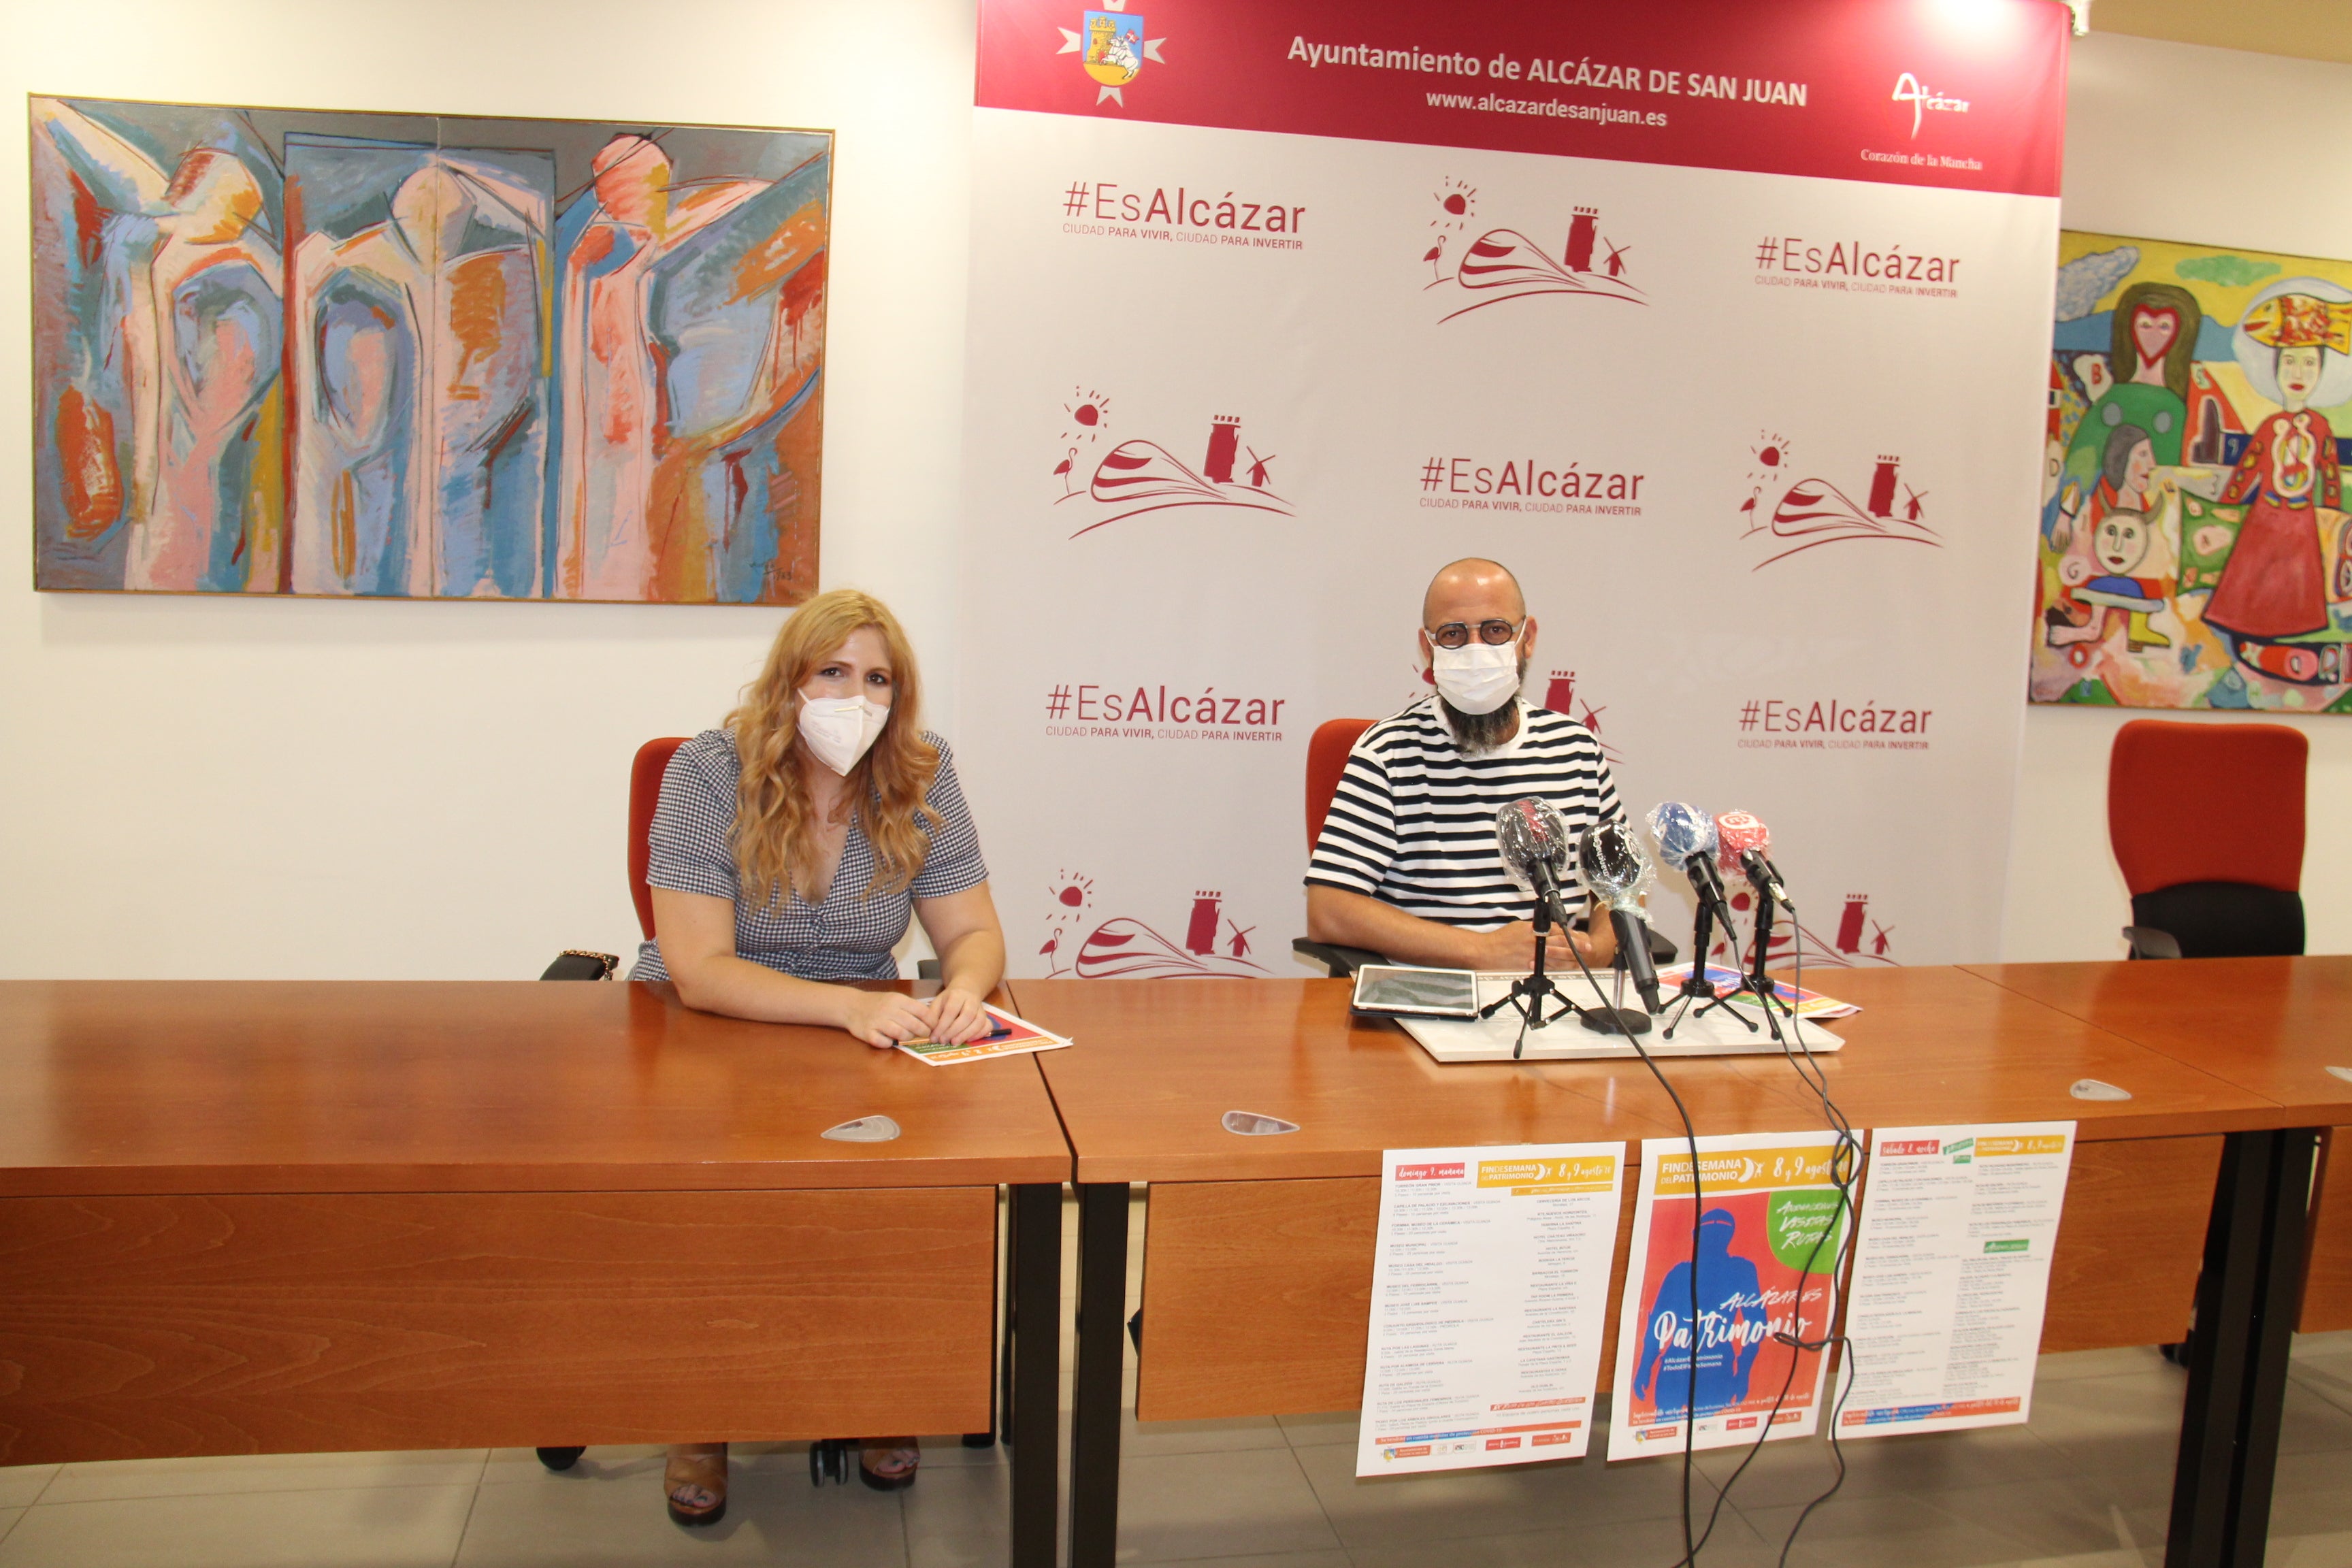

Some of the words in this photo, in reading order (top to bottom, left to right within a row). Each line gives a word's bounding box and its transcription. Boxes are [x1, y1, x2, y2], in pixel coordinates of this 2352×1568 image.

[1287, 36, 1481, 76] Ayuntamiento
[1488, 53, 1521, 80] de
[1527, 56, 1641, 91] ALCÁZAR
[1649, 69, 1680, 95] DE
[1687, 73, 1737, 100] SAN
[1742, 78, 1808, 107] JUAN
[1426, 92, 1667, 127] www.alcazardesanjuan.es
[1860, 148, 1908, 165] Corazón
[1910, 152, 1925, 165] de
[1927, 154, 1938, 167] la
[1940, 155, 1983, 170] Mancha
[1062, 181, 1305, 233] #EsAlcázar
[1062, 223, 1105, 235] CIUDAD
[1108, 226, 1137, 239] PARA
[1141, 229, 1173, 242] VIVIR,
[1176, 231, 1218, 245] CIUDAD
[1220, 235, 1250, 247] PARA
[1252, 238, 1303, 250] INVERTIR
[1756, 236, 1959, 283] #EsAlcázar
[1754, 275, 1792, 287] CIUDAD
[1793, 278, 1818, 289] PARA
[1821, 280, 1849, 292] VIVIR,
[1851, 282, 1886, 293] CIUDAD
[1889, 284, 1912, 295] PARA
[1915, 287, 1957, 298] INVERTIR
[1420, 457, 1644, 500] #EsAlcázar
[1420, 497, 1458, 509] CIUDAD
[1462, 500, 1489, 510] PARA
[1492, 501, 1522, 513] VIVIR,
[1524, 502, 1563, 514] CIUDAD
[1566, 504, 1592, 514] PARA
[1595, 505, 1642, 517] INVERTIR
[1045, 684, 1285, 725] #EsAlcázar
[1739, 700, 1932, 734] #EsAlcázar
[1045, 725, 1087, 737] CIUDAD
[1090, 727, 1120, 738] PARA
[1122, 728, 1154, 740] VIVIR,
[1157, 728, 1198, 740] CIUDAD
[1201, 730, 1230, 740] PARA
[1232, 731, 1282, 742] INVERTIR
[1737, 739, 1771, 749] CIUDAD
[1774, 739, 1797, 749] PARA
[1799, 740, 1825, 750] VIVIR,
[1827, 740, 1861, 749] CIUDAD
[1863, 740, 1885, 749] PARA
[1888, 740, 1929, 750] INVERTIR
[1399, 1166, 1427, 1179] domingo
[1558, 1163, 1567, 1177] 8
[1573, 1163, 1581, 1177] 9
[1773, 1157, 1784, 1177] 8
[1795, 1156, 1804, 1177] 9
[1805, 1160, 1833, 1179] agost
[1720, 1286, 1797, 1312] ALCÁZAR
